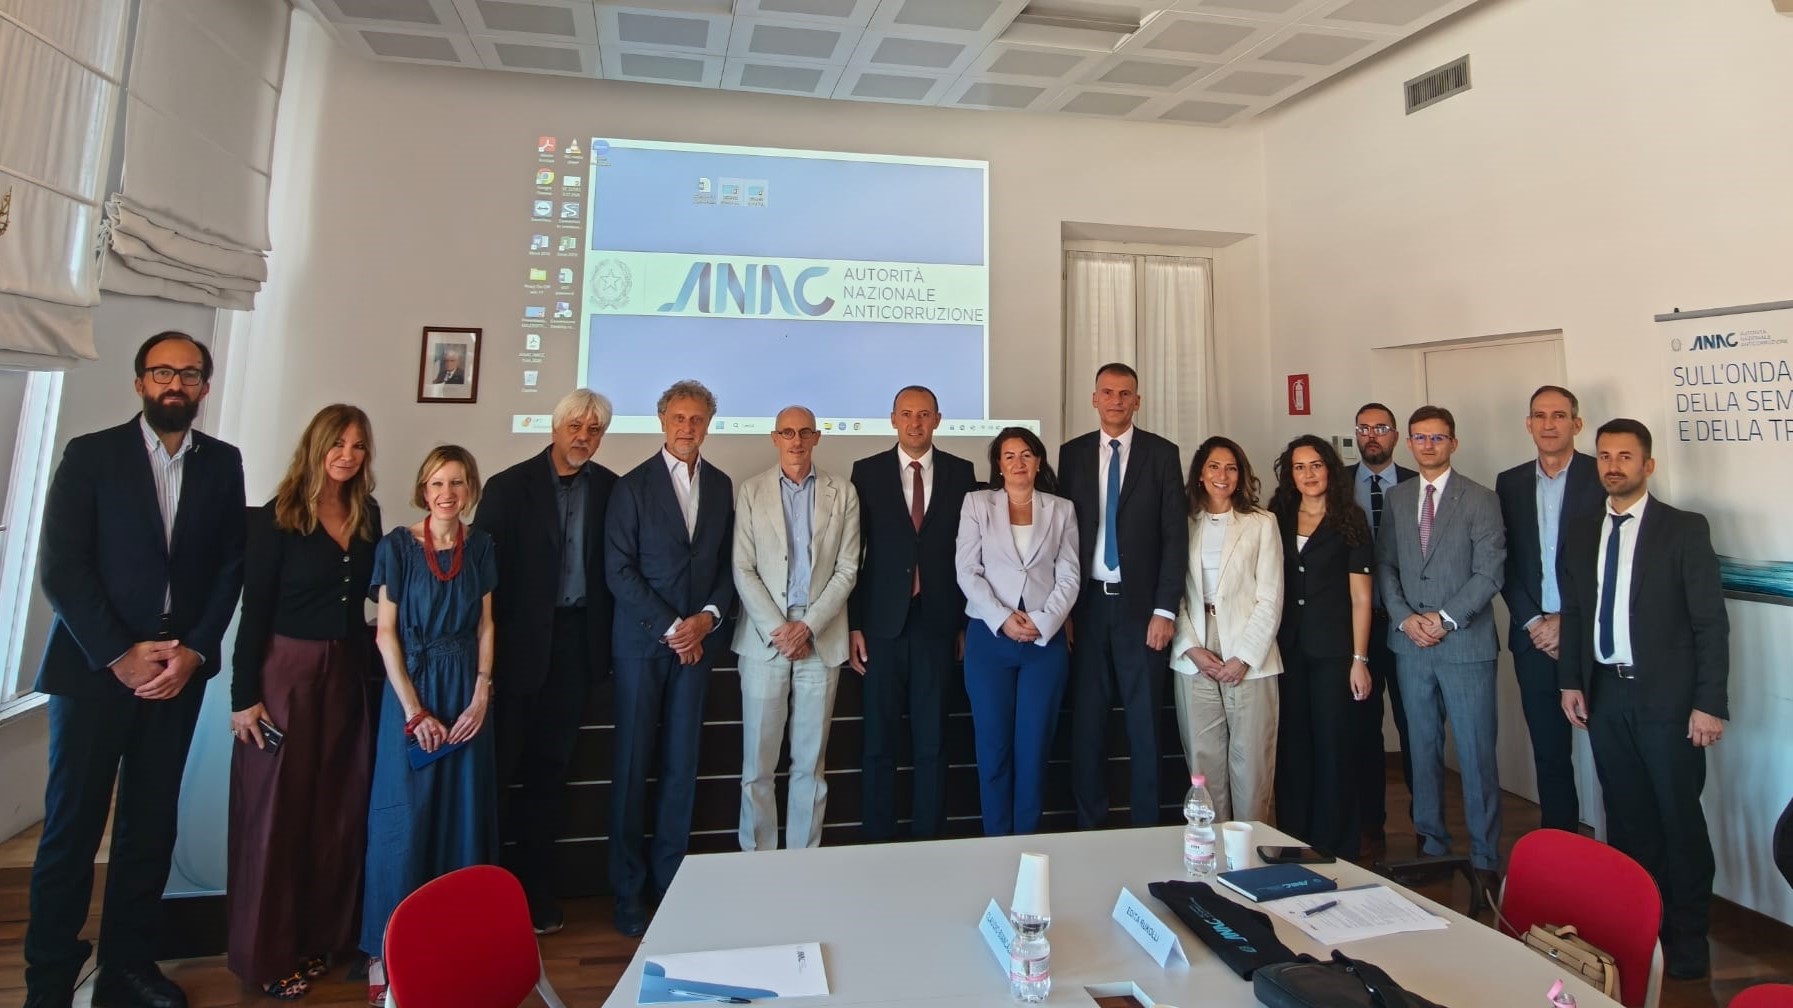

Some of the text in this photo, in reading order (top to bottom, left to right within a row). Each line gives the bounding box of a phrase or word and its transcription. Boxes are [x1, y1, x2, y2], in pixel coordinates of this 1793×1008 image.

[844, 267, 924, 283] AUTORITÀ
[657, 261, 835, 316] ANAC
[843, 286, 936, 301] NAZIONALE
[843, 304, 984, 322] ANTICORRUZIONE
[1689, 332, 1738, 351] ANAC
[1673, 360, 1792, 386] SULL'ONDA
[1676, 389, 1793, 412] DELLA SEM
[1679, 420, 1690, 441] E
[1696, 419, 1763, 441] DELLA
